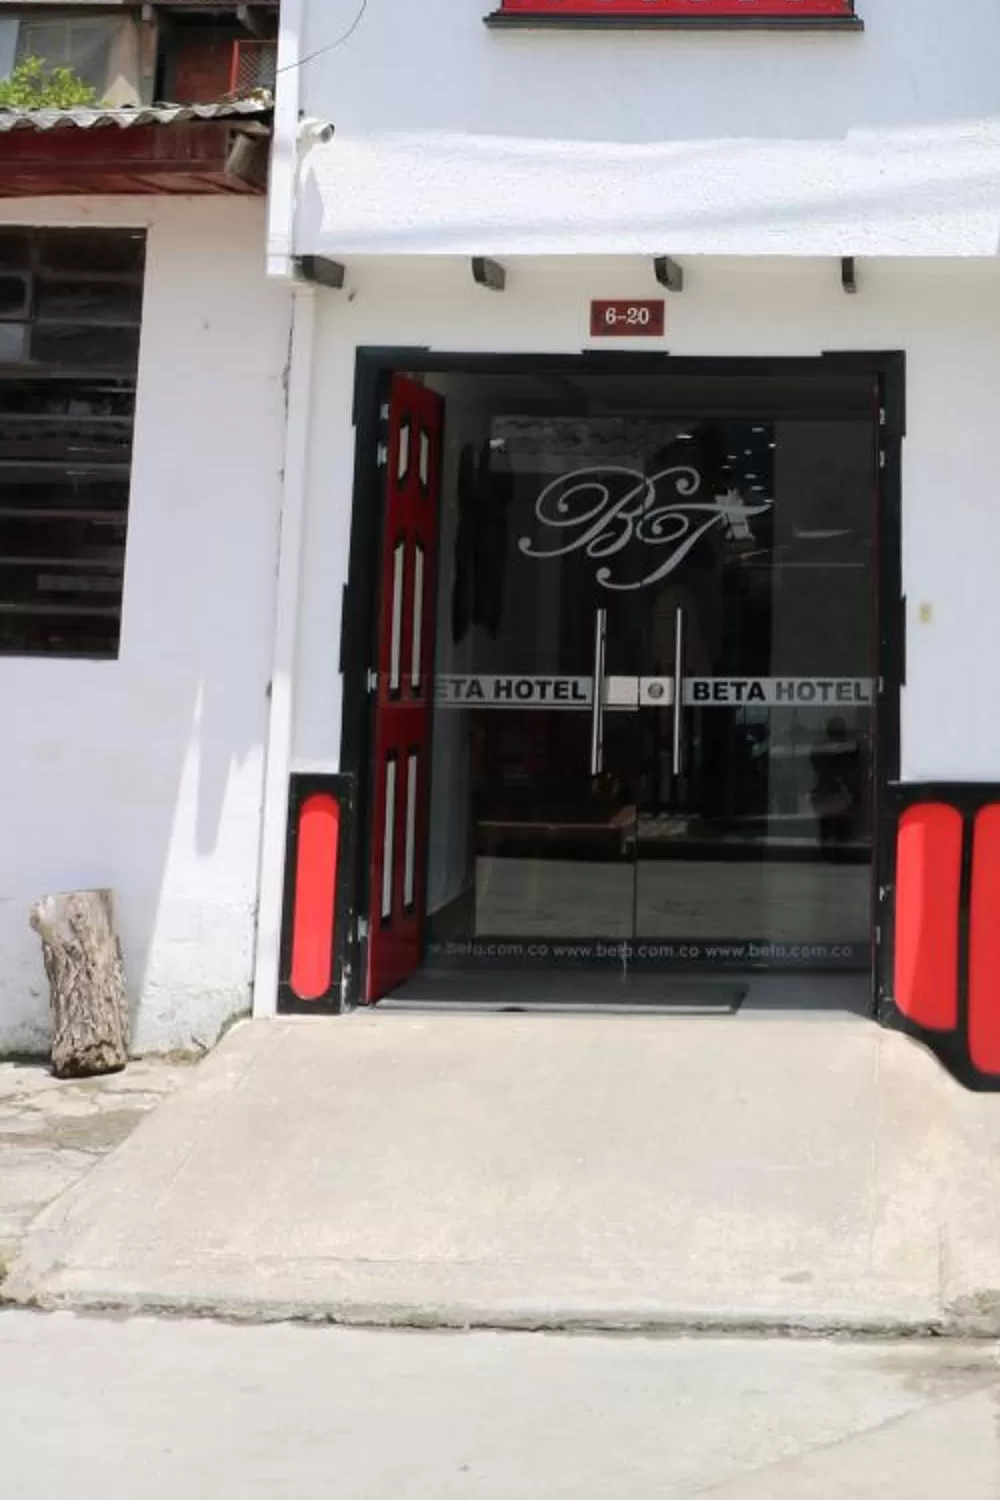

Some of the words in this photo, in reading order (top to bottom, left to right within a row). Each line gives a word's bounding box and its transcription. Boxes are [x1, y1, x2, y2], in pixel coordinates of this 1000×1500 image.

[605, 307, 649, 325] 6-20
[494, 679, 588, 700] HOTEL
[692, 681, 767, 701] BETA
[775, 681, 870, 701] HOTEL
